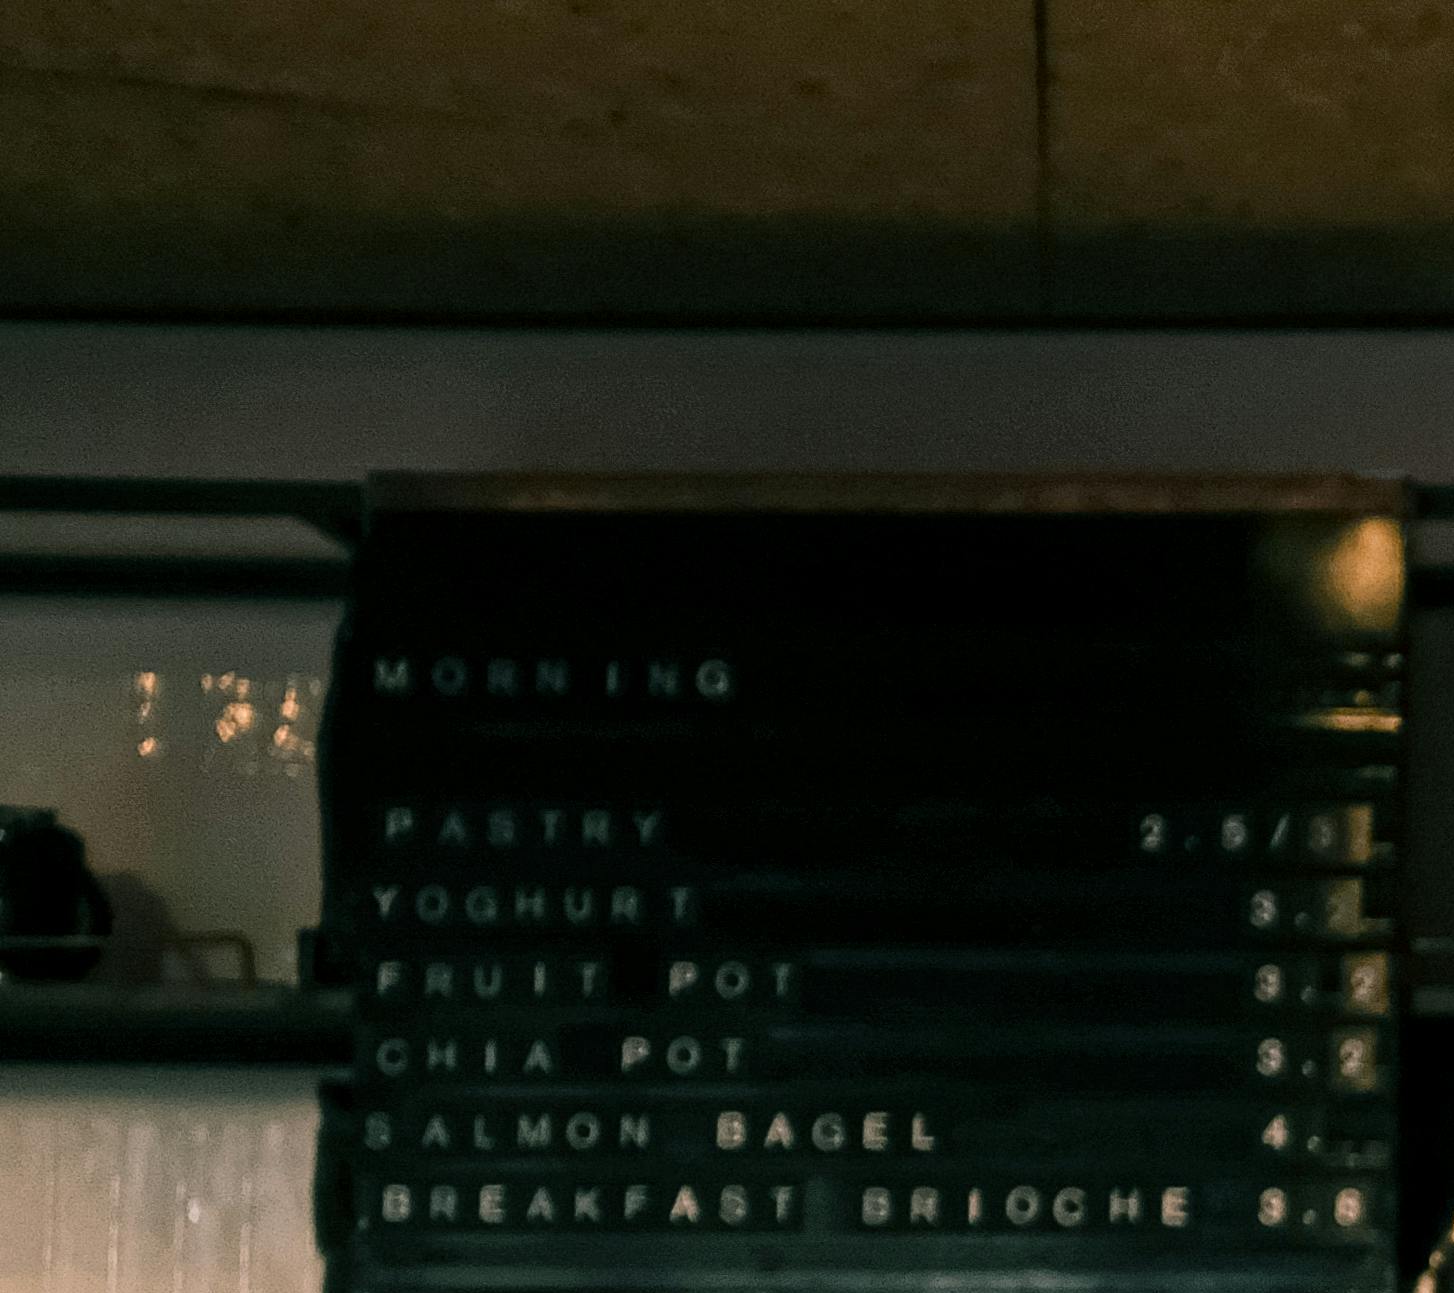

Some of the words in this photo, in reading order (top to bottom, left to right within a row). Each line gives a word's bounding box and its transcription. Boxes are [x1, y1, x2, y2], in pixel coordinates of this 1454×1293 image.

[374, 658, 736, 698] MORNING
[386, 808, 659, 846] PASTRY
[373, 886, 692, 926] YOGHURT
[377, 961, 600, 999] FRUIT
[668, 961, 793, 1000] POT
[376, 1036, 553, 1076] CHIA
[620, 1034, 747, 1075] POT
[364, 1110, 652, 1152] SALMON
[715, 1110, 936, 1153] BAGEL
[382, 1183, 796, 1226] BREAKFAST
[861, 1184, 1190, 1228] BRIOCHE
